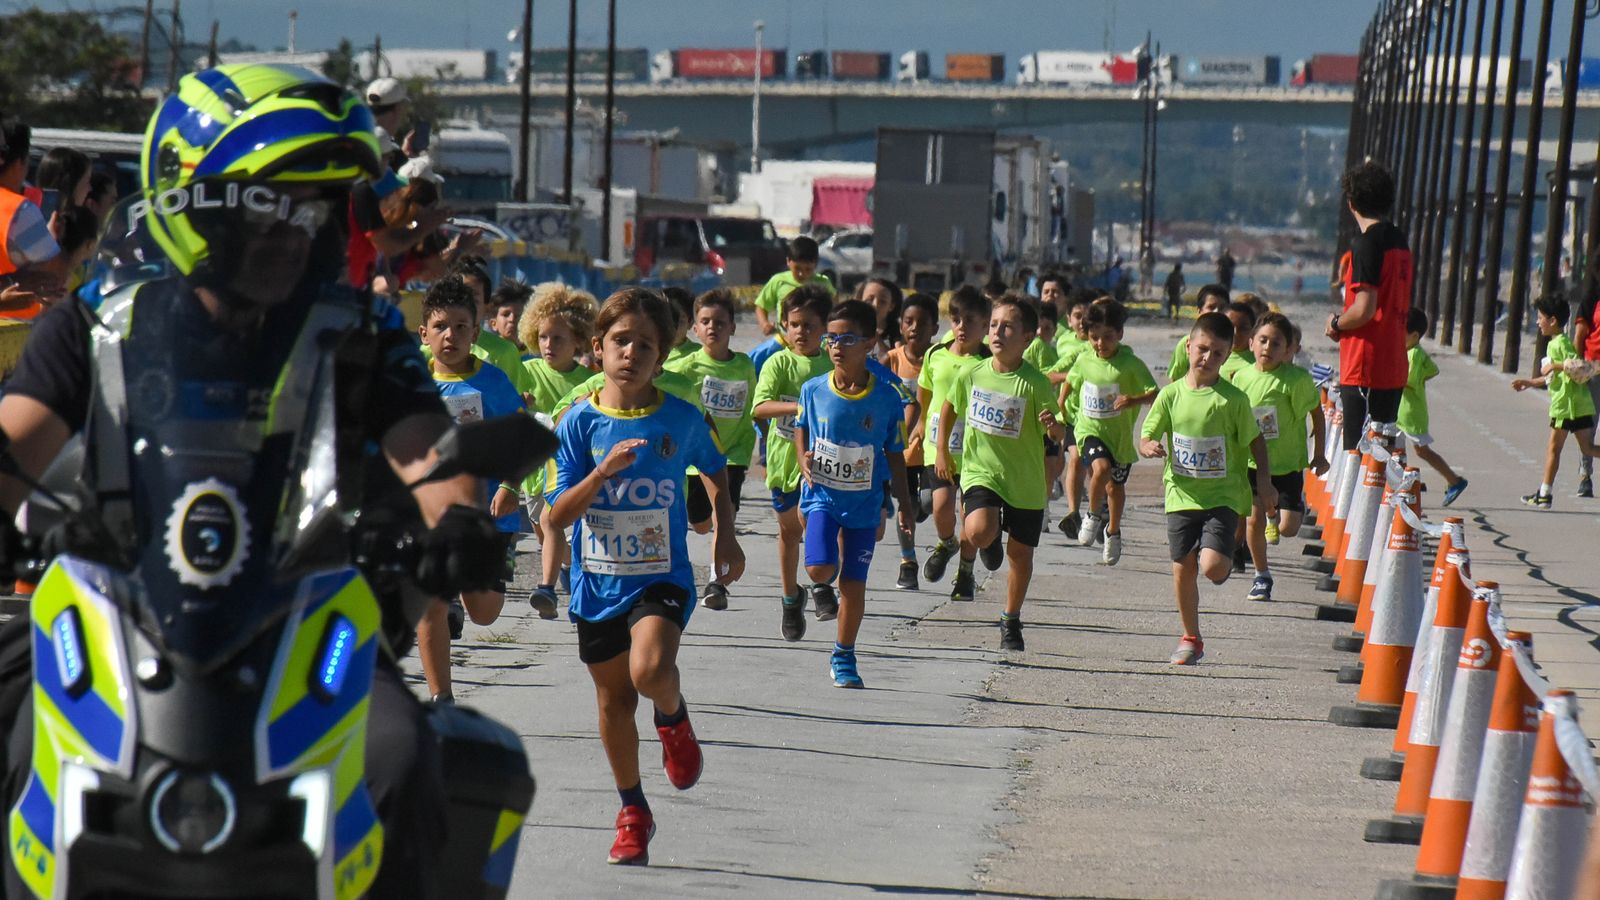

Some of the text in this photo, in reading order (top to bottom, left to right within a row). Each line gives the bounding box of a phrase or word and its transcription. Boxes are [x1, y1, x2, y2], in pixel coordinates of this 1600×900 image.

[126, 182, 317, 238] POLICIA
[704, 391, 735, 409] 1458
[972, 402, 1004, 424] 1465
[816, 456, 852, 478] 1519
[1175, 449, 1206, 467] 1247
[591, 477, 676, 508] VOS
[588, 531, 640, 558] 1113
